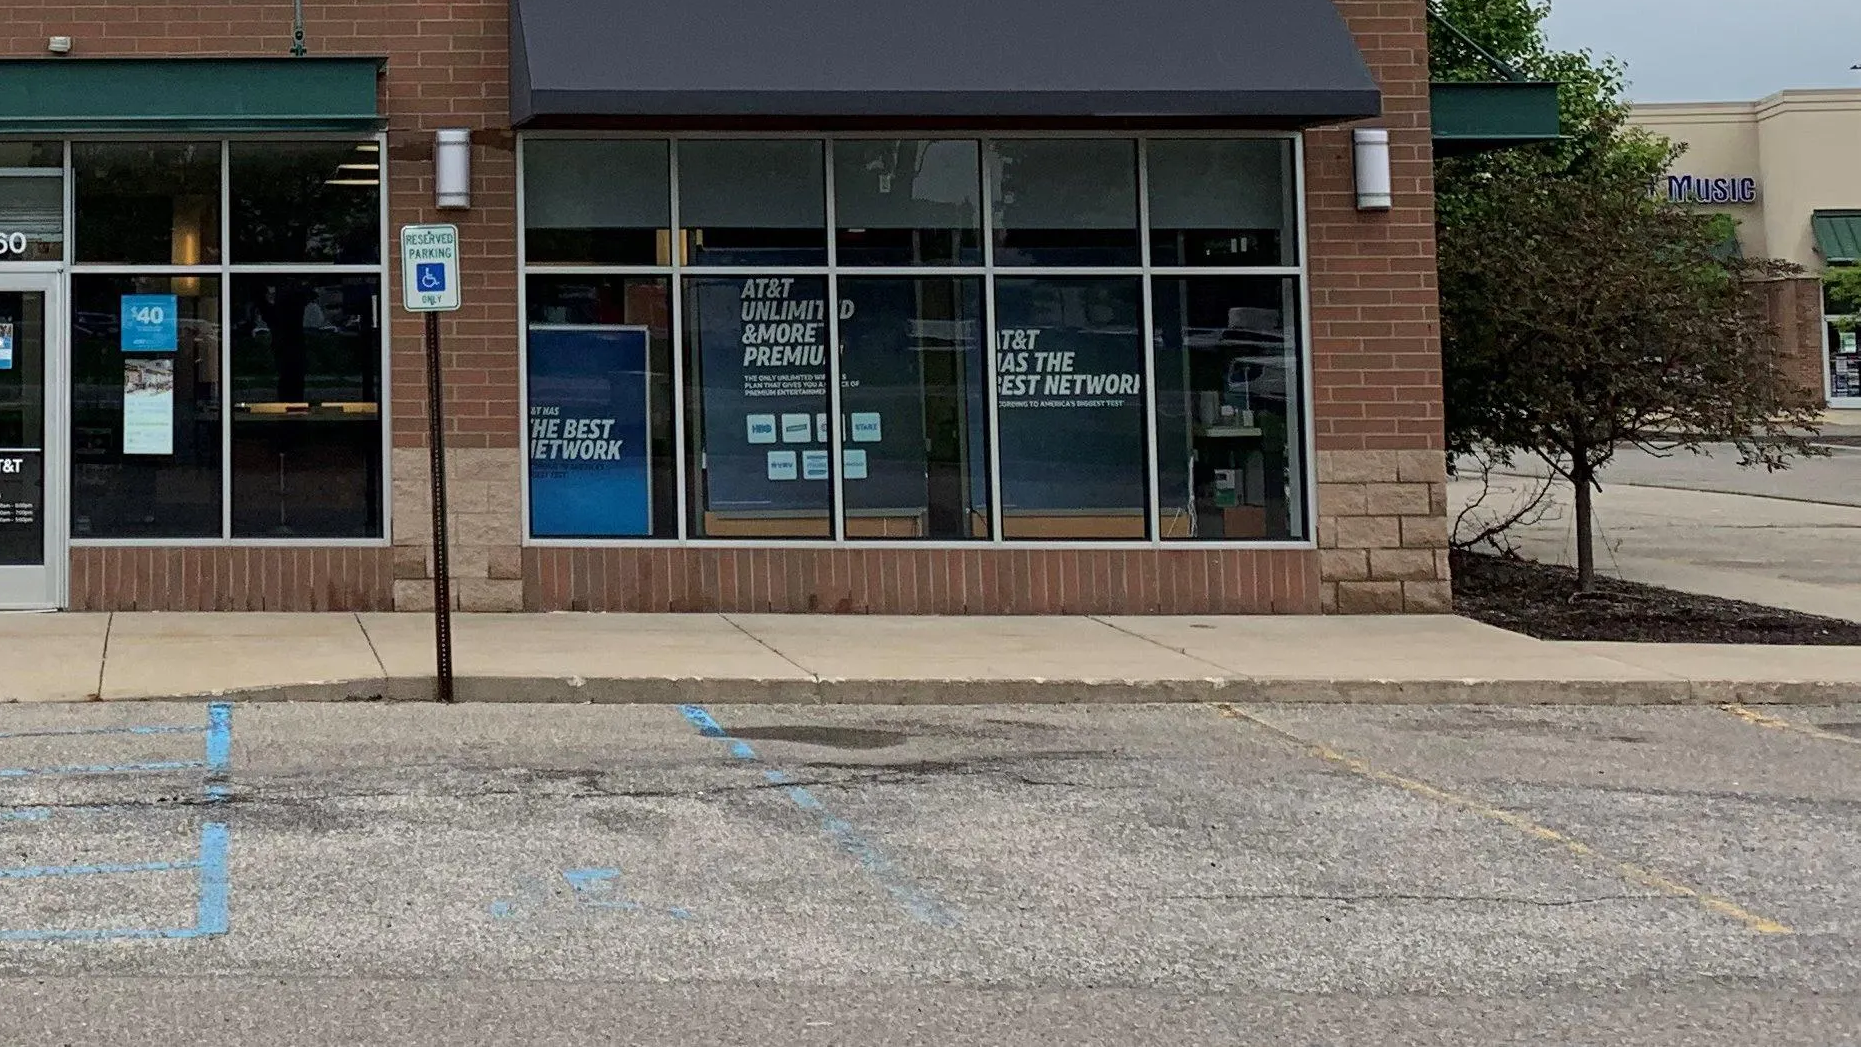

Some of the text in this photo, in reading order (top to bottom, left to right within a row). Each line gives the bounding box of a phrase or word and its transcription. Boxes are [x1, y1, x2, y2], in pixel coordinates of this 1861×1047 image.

[406, 233, 453, 245] RESERVED
[409, 247, 452, 259] PARKING
[740, 278, 794, 299] AT&T
[421, 295, 442, 304] ONLY
[741, 299, 855, 321] UNLIMITD
[1034, 351, 1075, 373] THE
[758, 374, 777, 382] ONLY
[777, 374, 813, 382] UNLIMITED
[744, 389, 776, 397] PREMIUM
[542, 406, 559, 415] HAS
[563, 419, 615, 439] BEST
